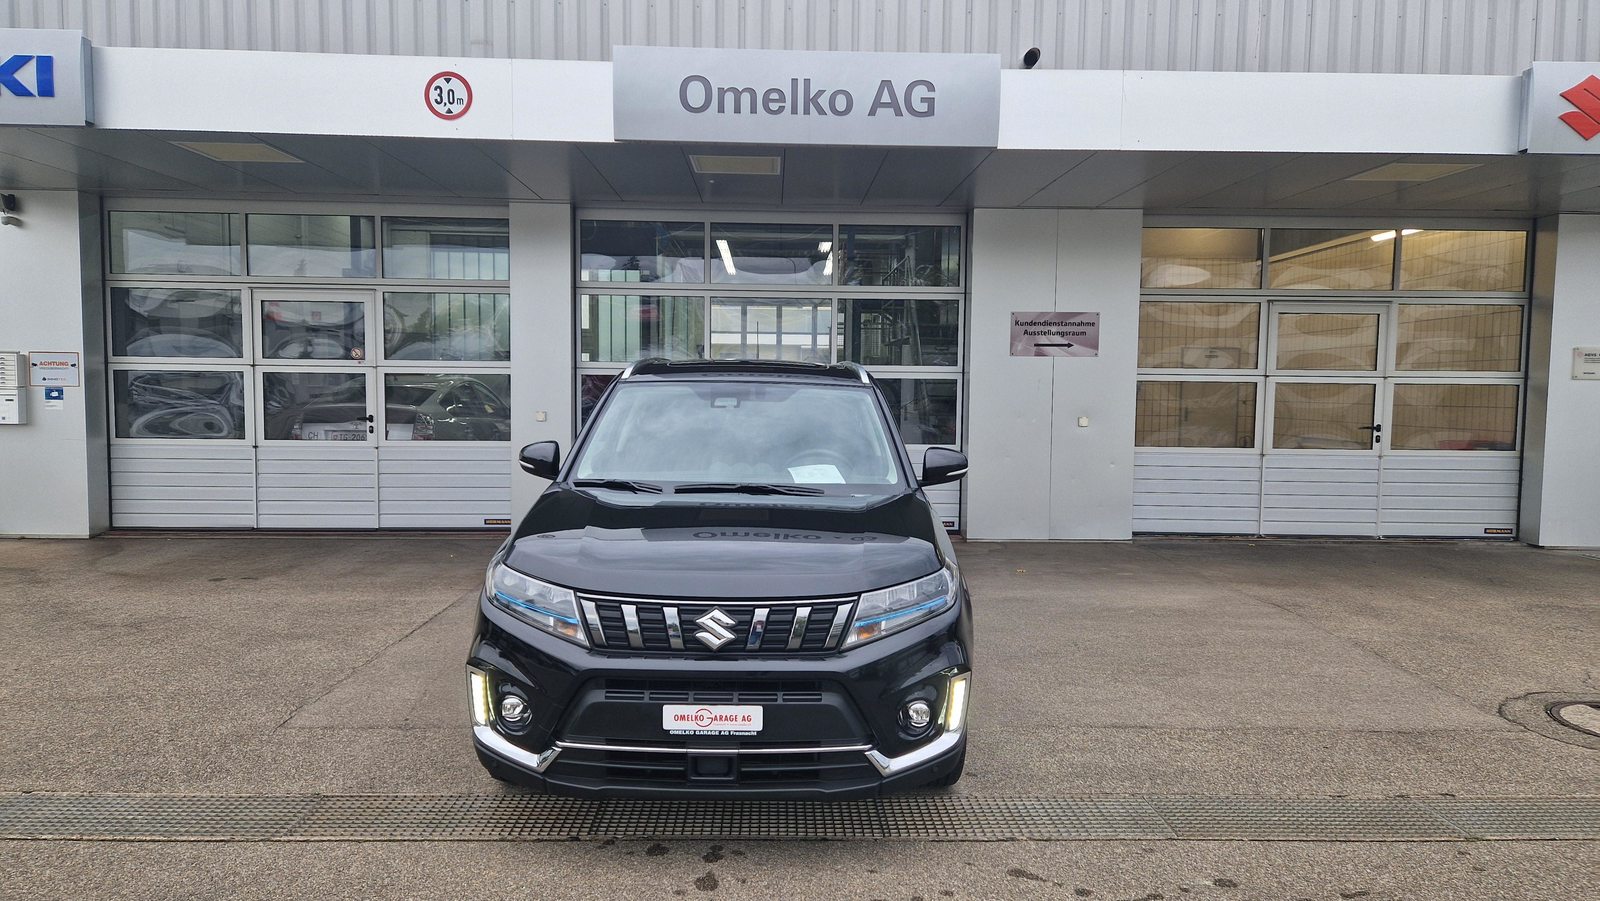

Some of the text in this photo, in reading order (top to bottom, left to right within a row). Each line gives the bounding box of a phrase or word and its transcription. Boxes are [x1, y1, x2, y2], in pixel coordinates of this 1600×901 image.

[679, 74, 936, 118] Omelko AG
[1014, 319, 1096, 327] Kundendienstannahme
[1023, 329, 1087, 338] Ausstellungsraum
[673, 714, 705, 722] OMELKO
